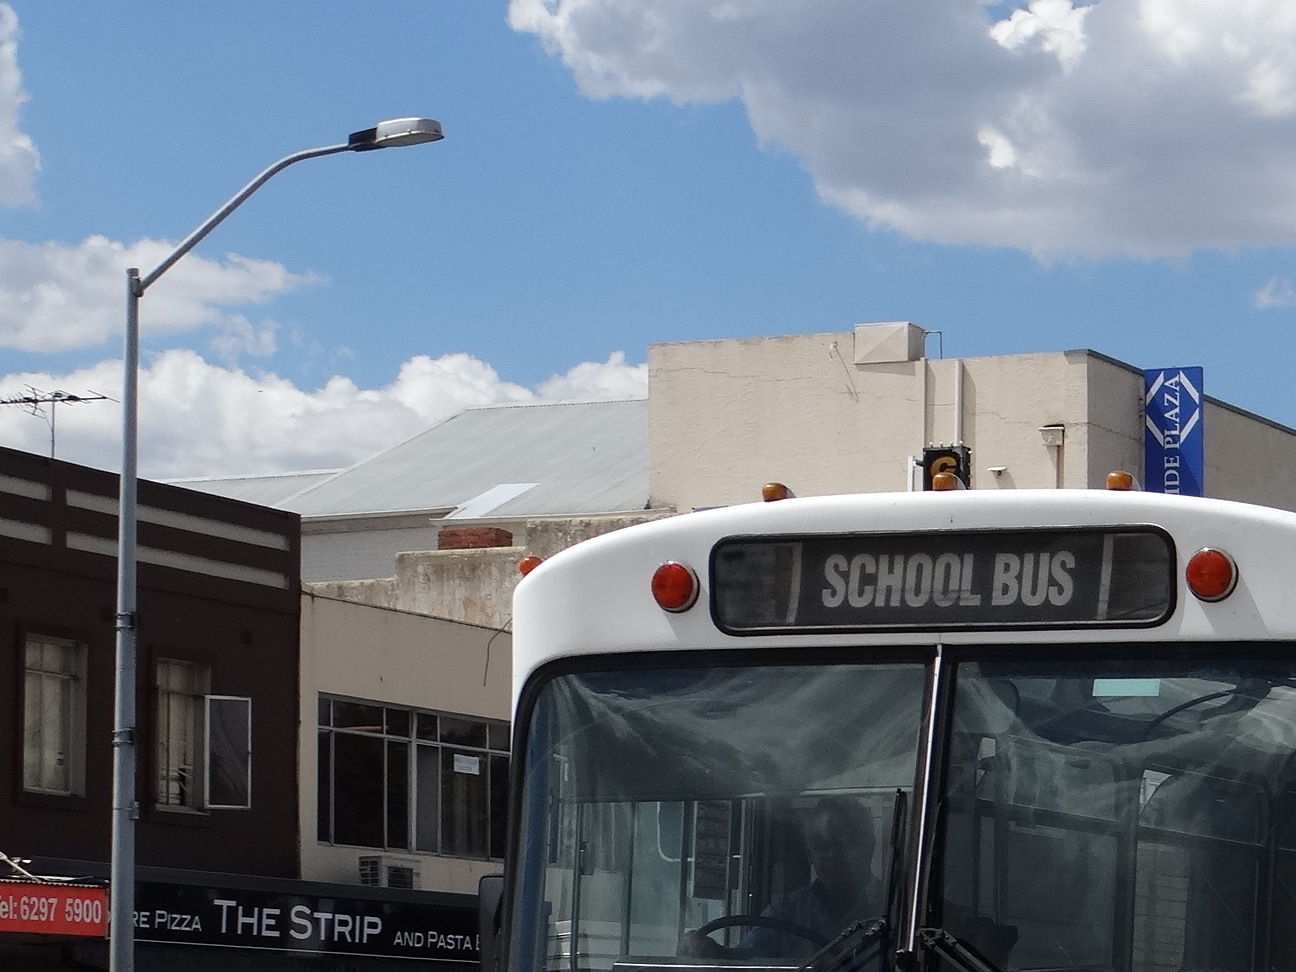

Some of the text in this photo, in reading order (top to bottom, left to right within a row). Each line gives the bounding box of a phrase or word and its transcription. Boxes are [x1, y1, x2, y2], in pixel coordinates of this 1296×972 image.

[1164, 374, 1180, 450] PLAZA
[822, 550, 1076, 608] SCHOOL BUS
[0, 895, 16, 919] el:
[20, 896, 58, 921] 6297
[65, 898, 102, 924] 5900
[154, 910, 203, 932] PIZZA
[213, 899, 281, 937] THE
[289, 905, 382, 943] STRIP
[393, 931, 424, 948] AND
[427, 931, 472, 950] PASTA
